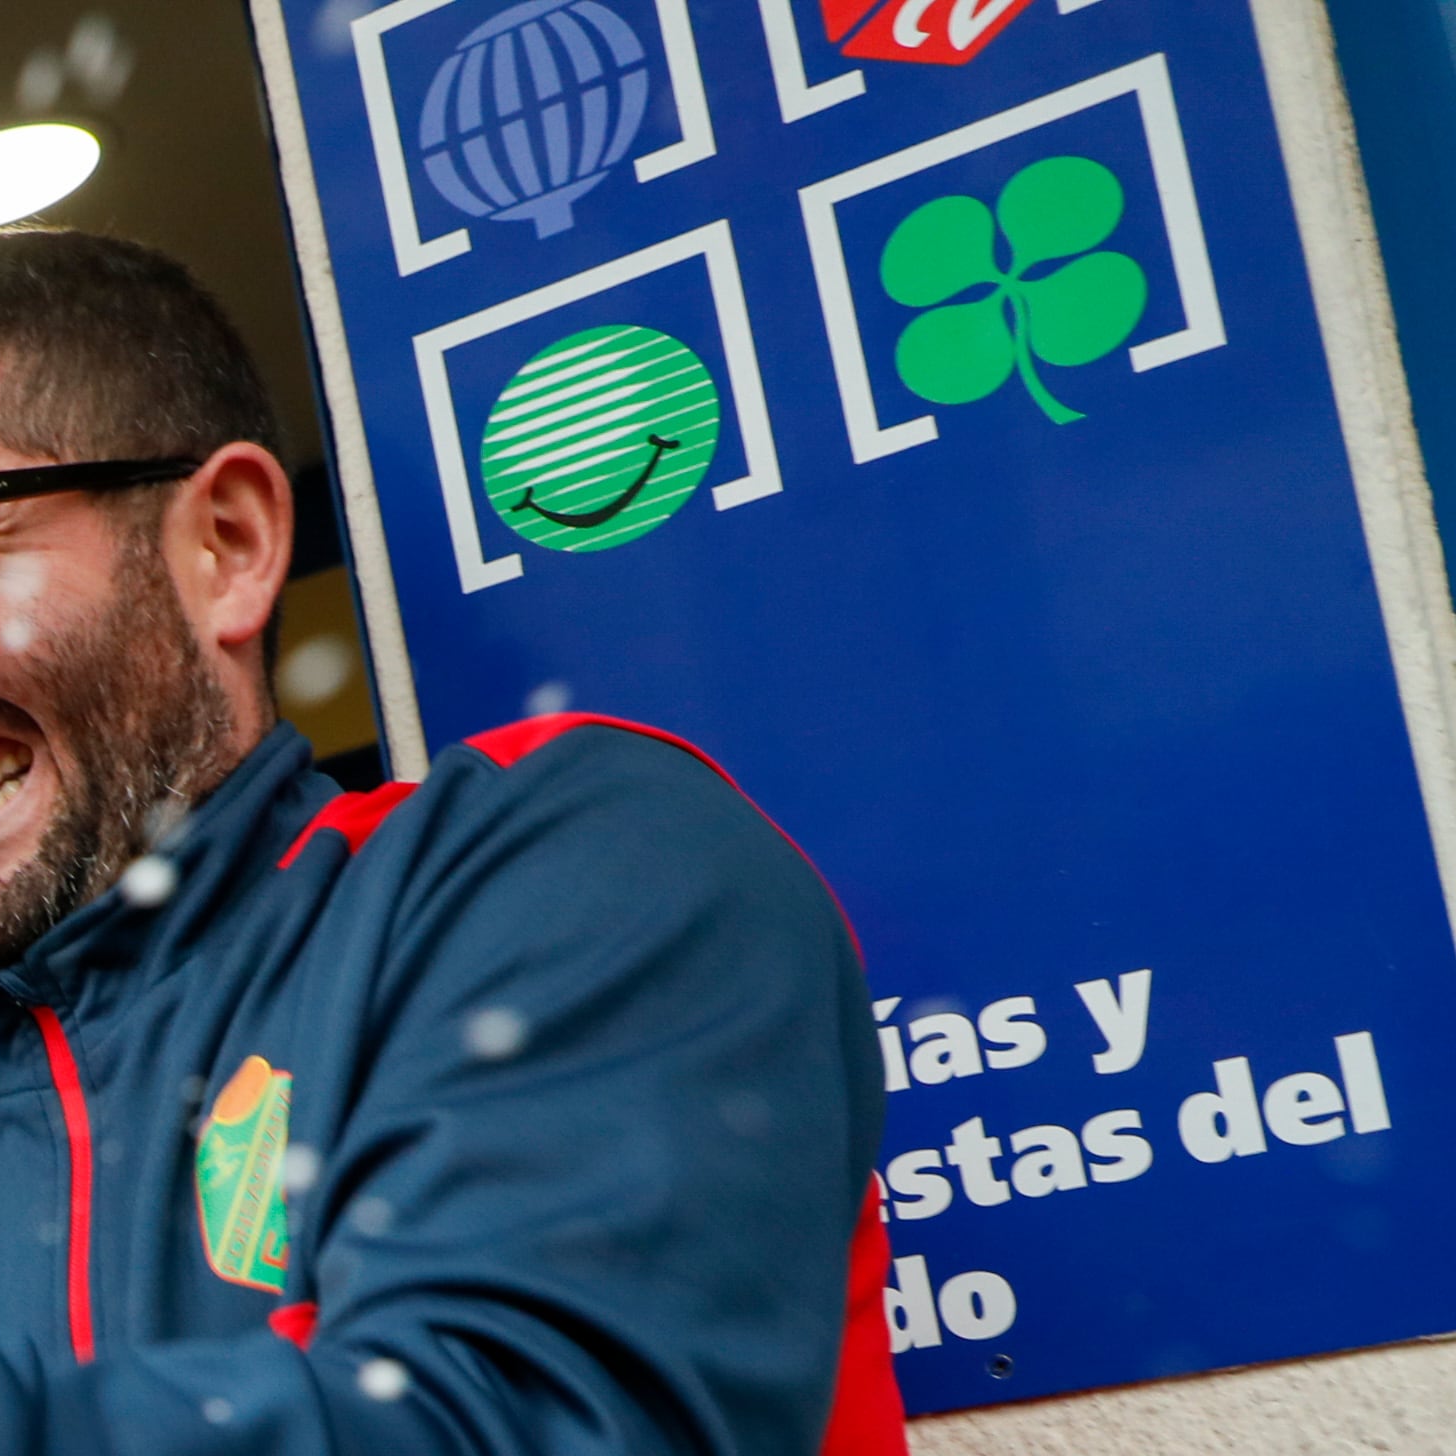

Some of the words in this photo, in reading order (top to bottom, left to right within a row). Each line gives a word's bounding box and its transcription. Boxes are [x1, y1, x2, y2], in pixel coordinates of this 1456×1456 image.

[872, 996, 1047, 1093] ías
[1074, 968, 1152, 1074] y
[872, 1108, 1153, 1224] stas
[1177, 1030, 1392, 1163] del
[883, 1253, 1018, 1355] do
